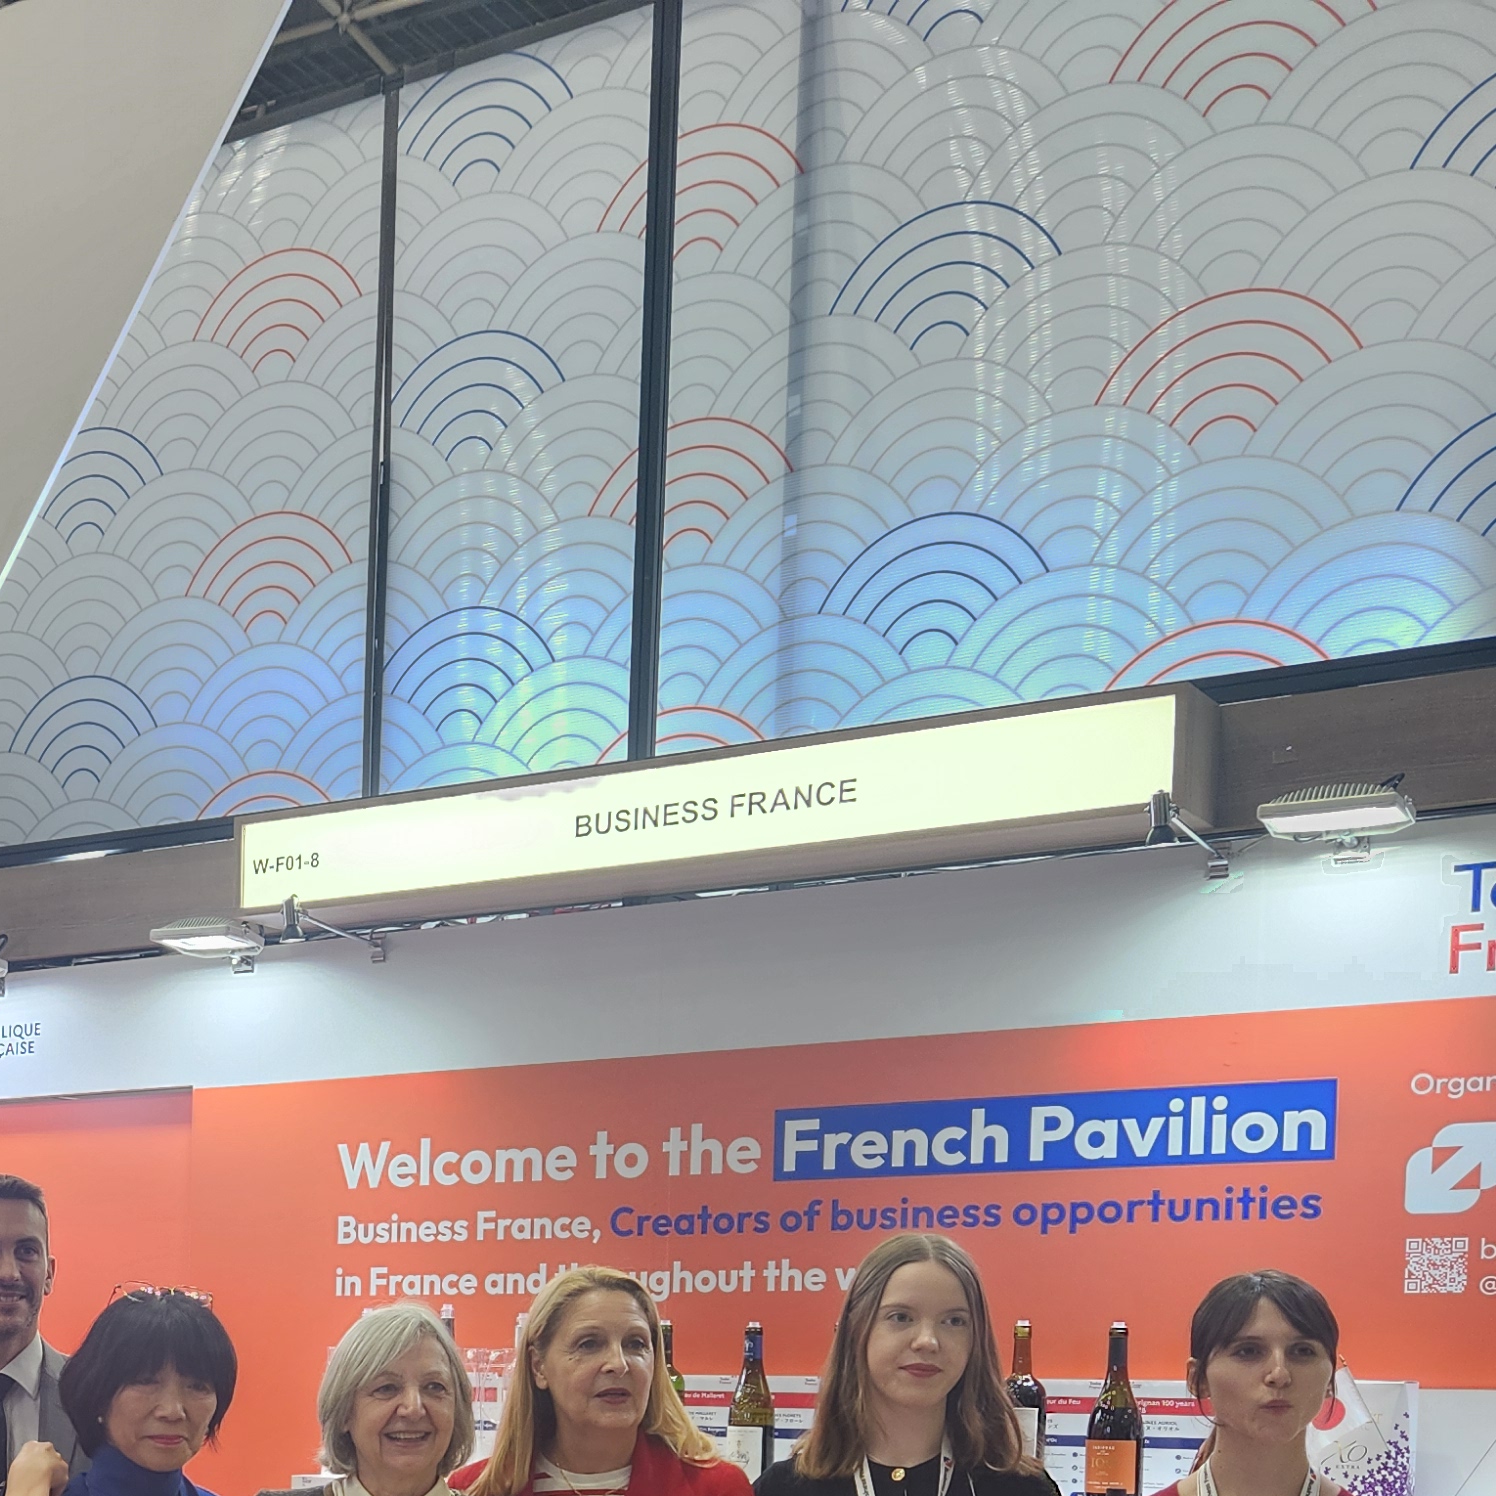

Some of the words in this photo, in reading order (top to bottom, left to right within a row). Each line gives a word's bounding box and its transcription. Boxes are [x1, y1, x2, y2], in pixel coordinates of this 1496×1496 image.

[574, 799, 718, 839] BUSINESS
[730, 779, 858, 819] FRANCE
[253, 852, 319, 876] W-F01-8
[338, 1137, 577, 1189] Welcome
[589, 1131, 648, 1179] to
[662, 1123, 761, 1176] the
[783, 1109, 1008, 1173] French
[1030, 1096, 1326, 1162] Pavilion
[338, 1213, 468, 1244] Business
[477, 1210, 601, 1243] France,
[610, 1204, 770, 1237] Creators
[780, 1199, 823, 1233] of
[831, 1197, 1002, 1232] business
[1012, 1184, 1323, 1235] opportunities
[336, 1267, 362, 1296] in
[369, 1267, 477, 1296] France
[484, 1263, 546, 1295] and
[764, 1258, 827, 1291] the
